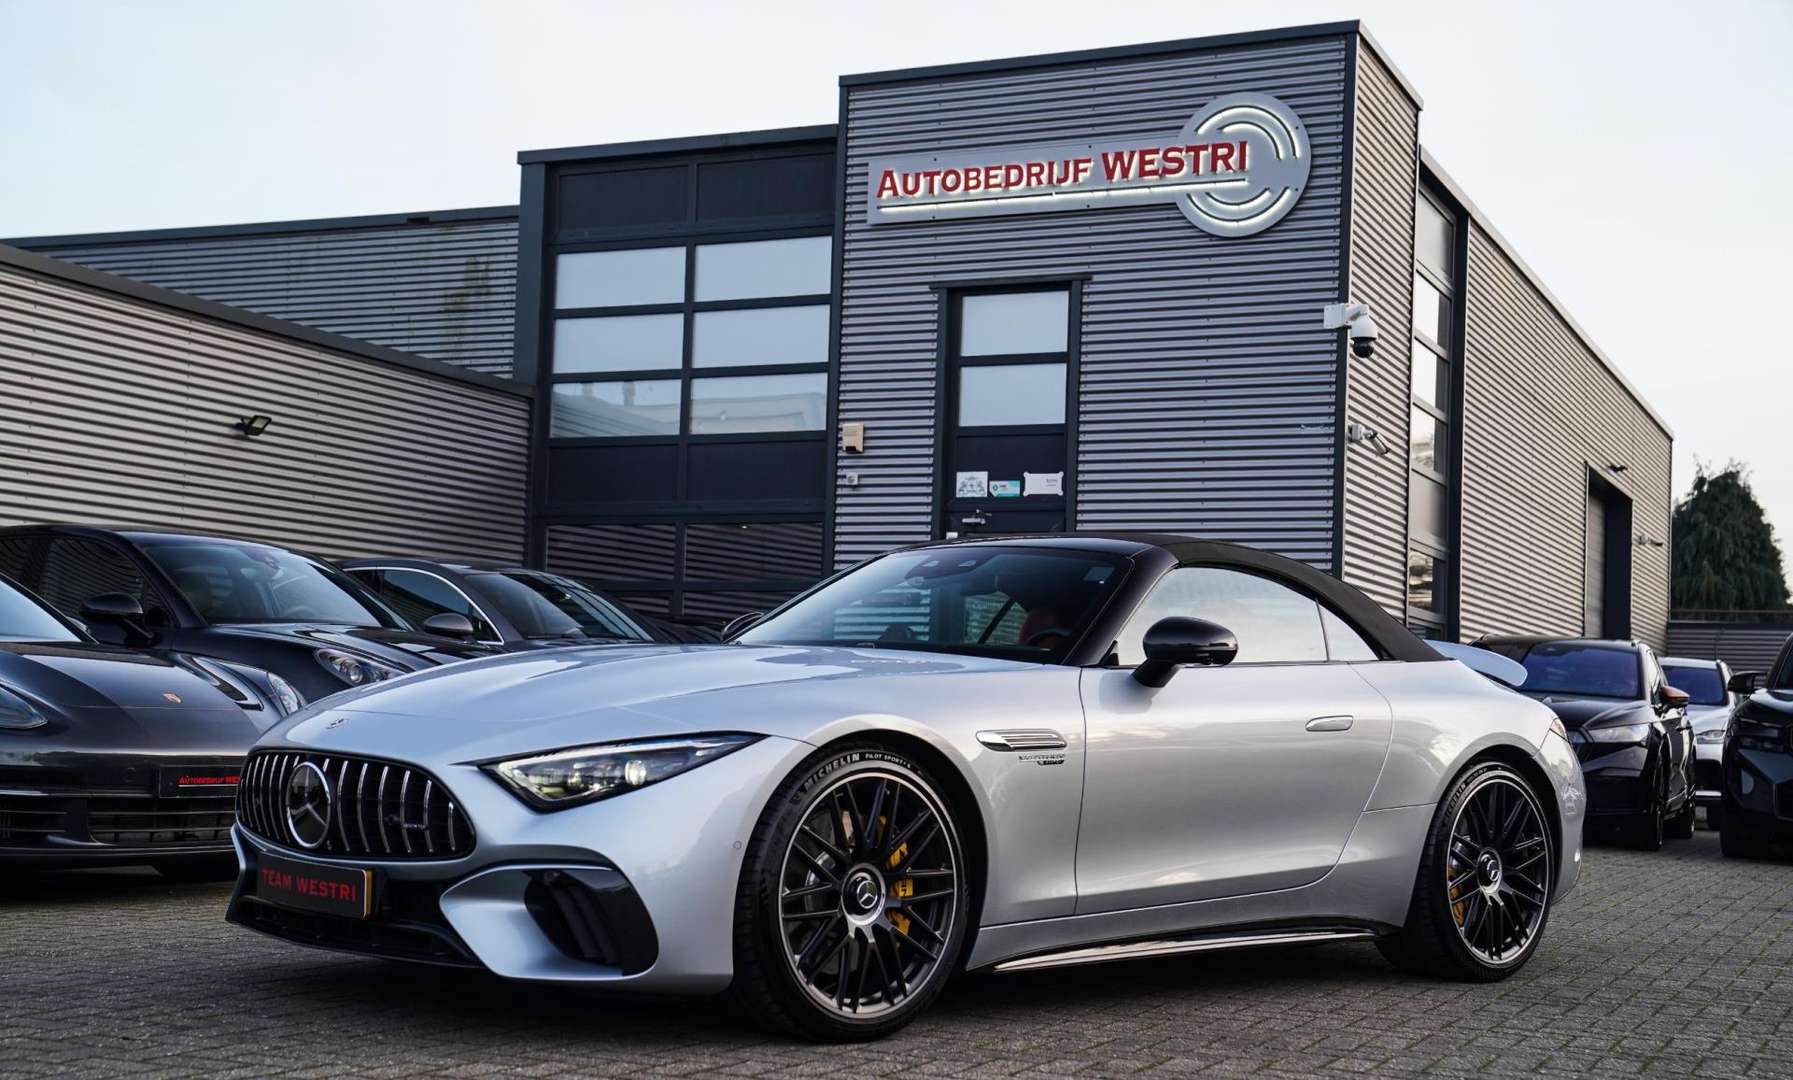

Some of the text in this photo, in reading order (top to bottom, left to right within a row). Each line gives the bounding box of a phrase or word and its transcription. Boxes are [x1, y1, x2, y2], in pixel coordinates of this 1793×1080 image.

[876, 140, 1248, 198] AUTOBEDRIJF WESTRI
[804, 752, 860, 792] MICHELIN
[262, 868, 357, 902] TEAM WESTRI
